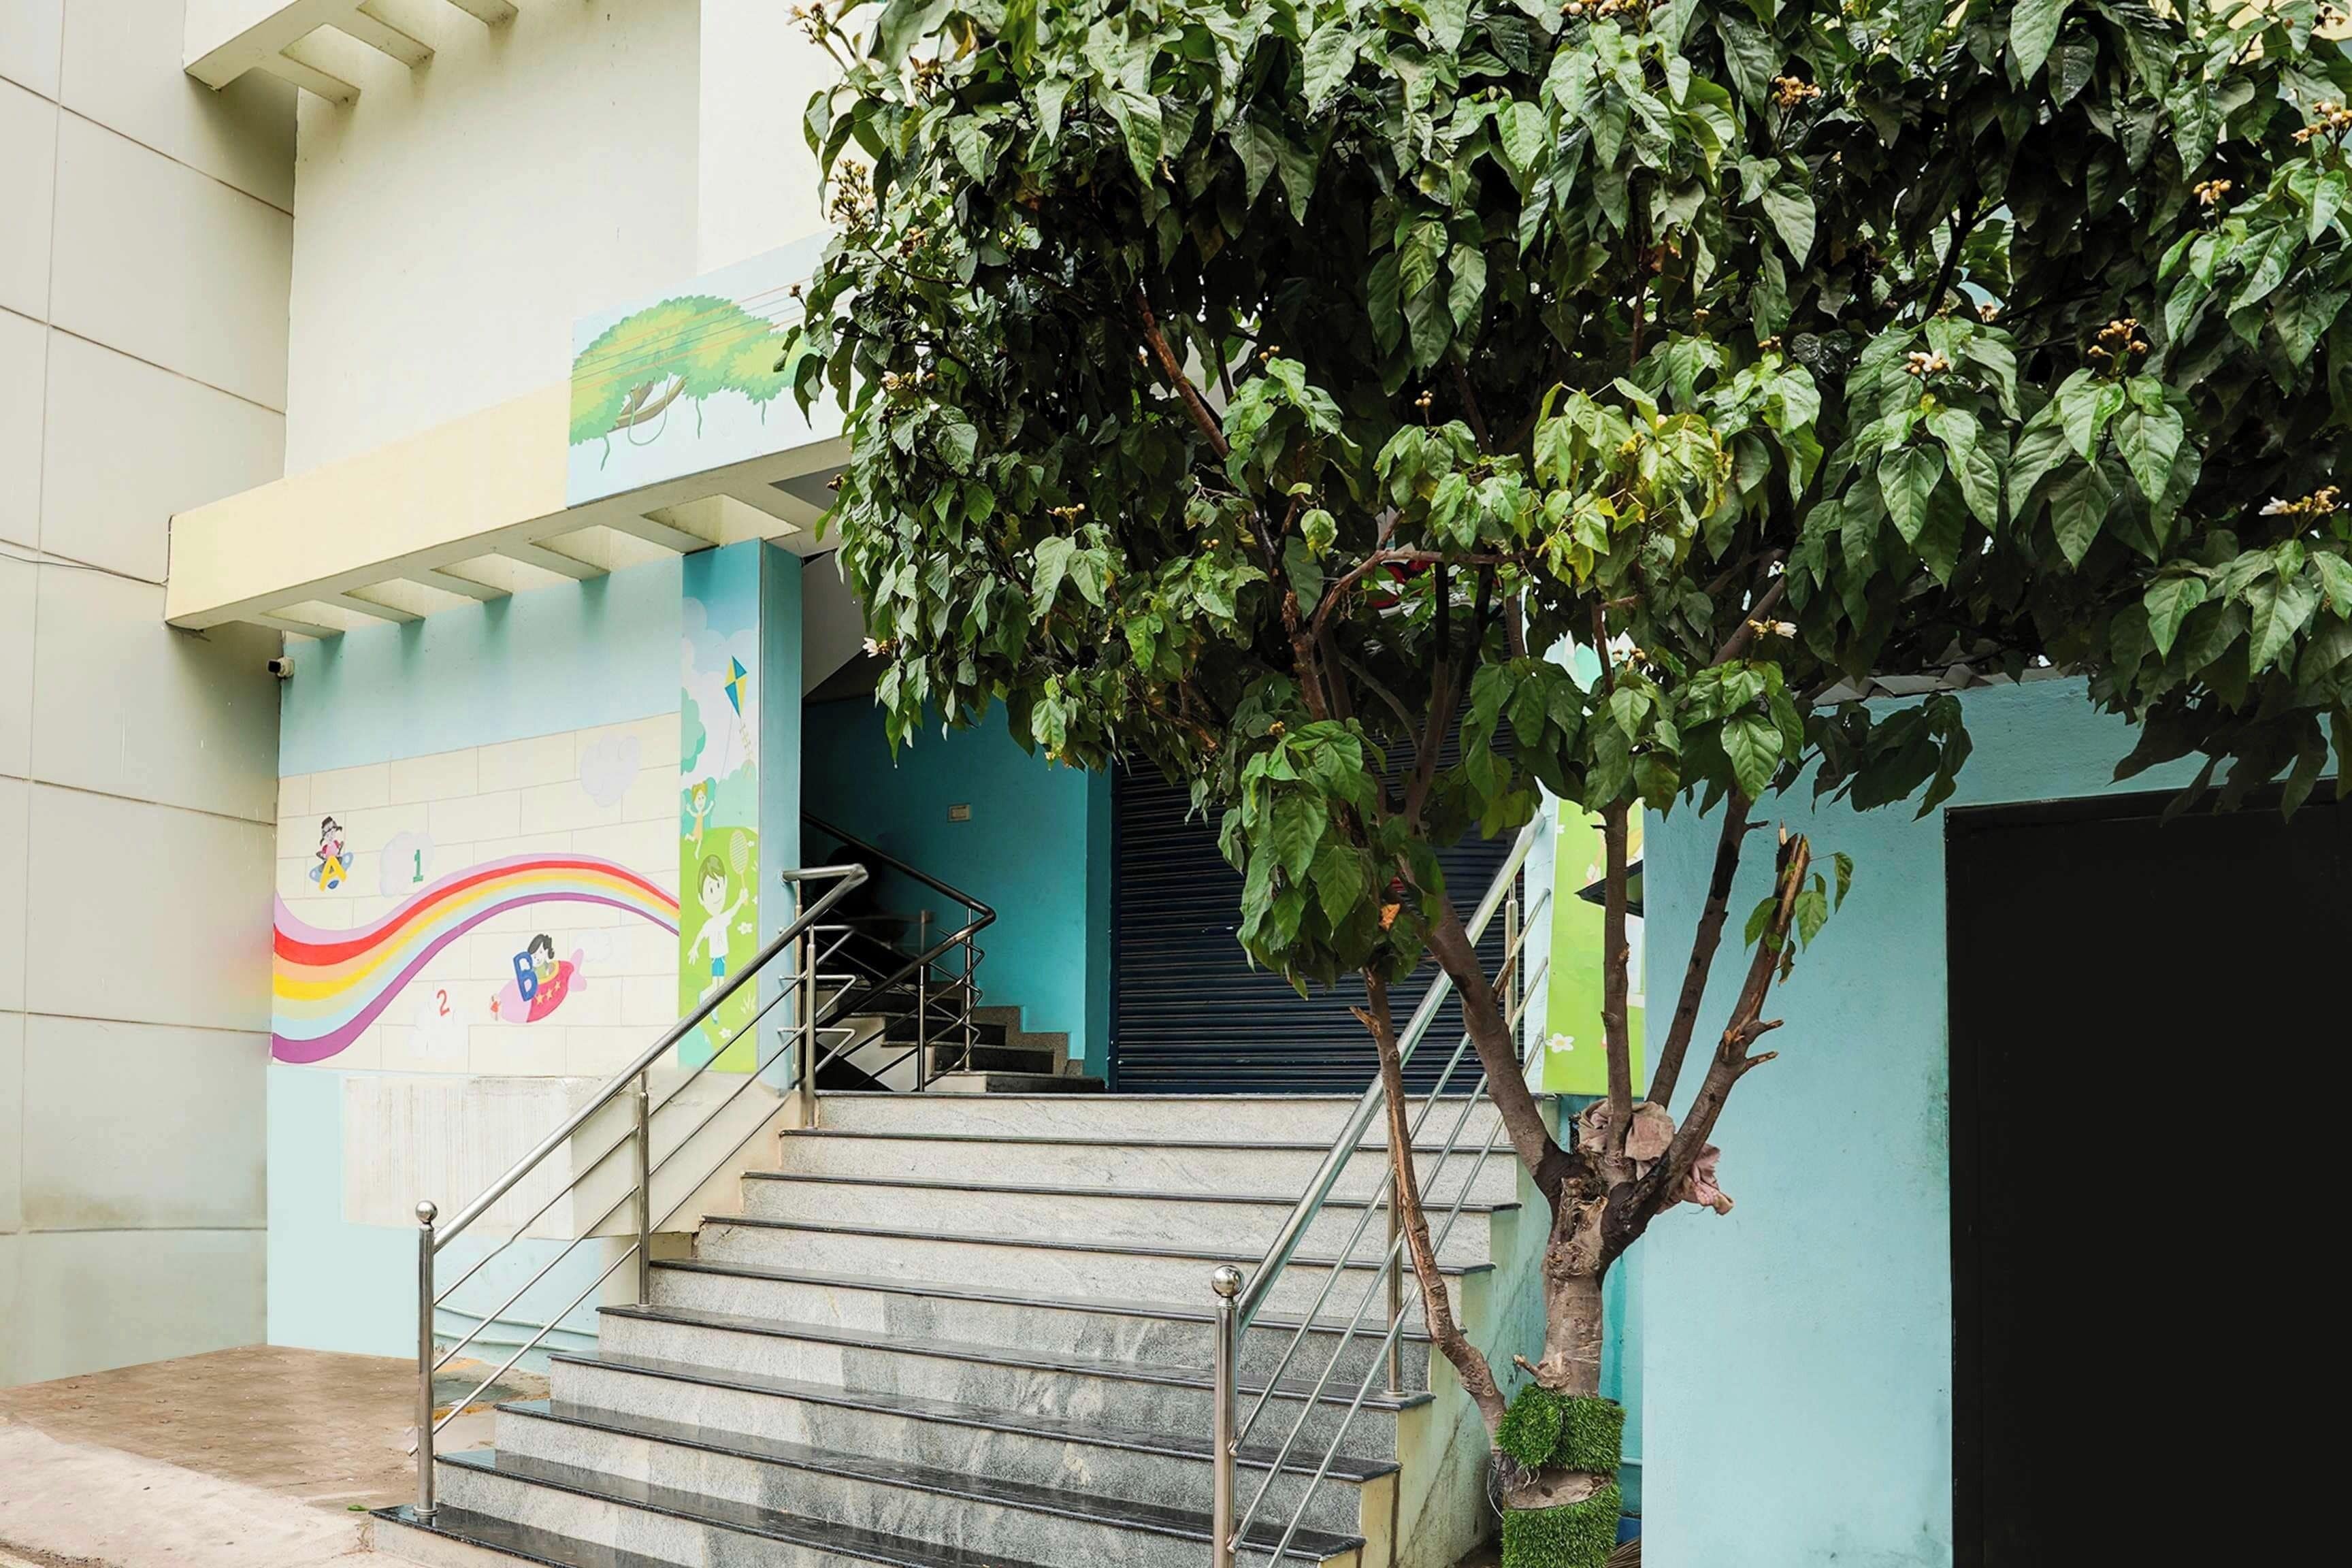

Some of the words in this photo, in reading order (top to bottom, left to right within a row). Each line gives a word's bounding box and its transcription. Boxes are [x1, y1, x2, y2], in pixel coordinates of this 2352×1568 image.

[319, 855, 346, 892] A
[413, 849, 423, 883] 1
[513, 951, 538, 1002] B
[437, 990, 450, 1016] 2
